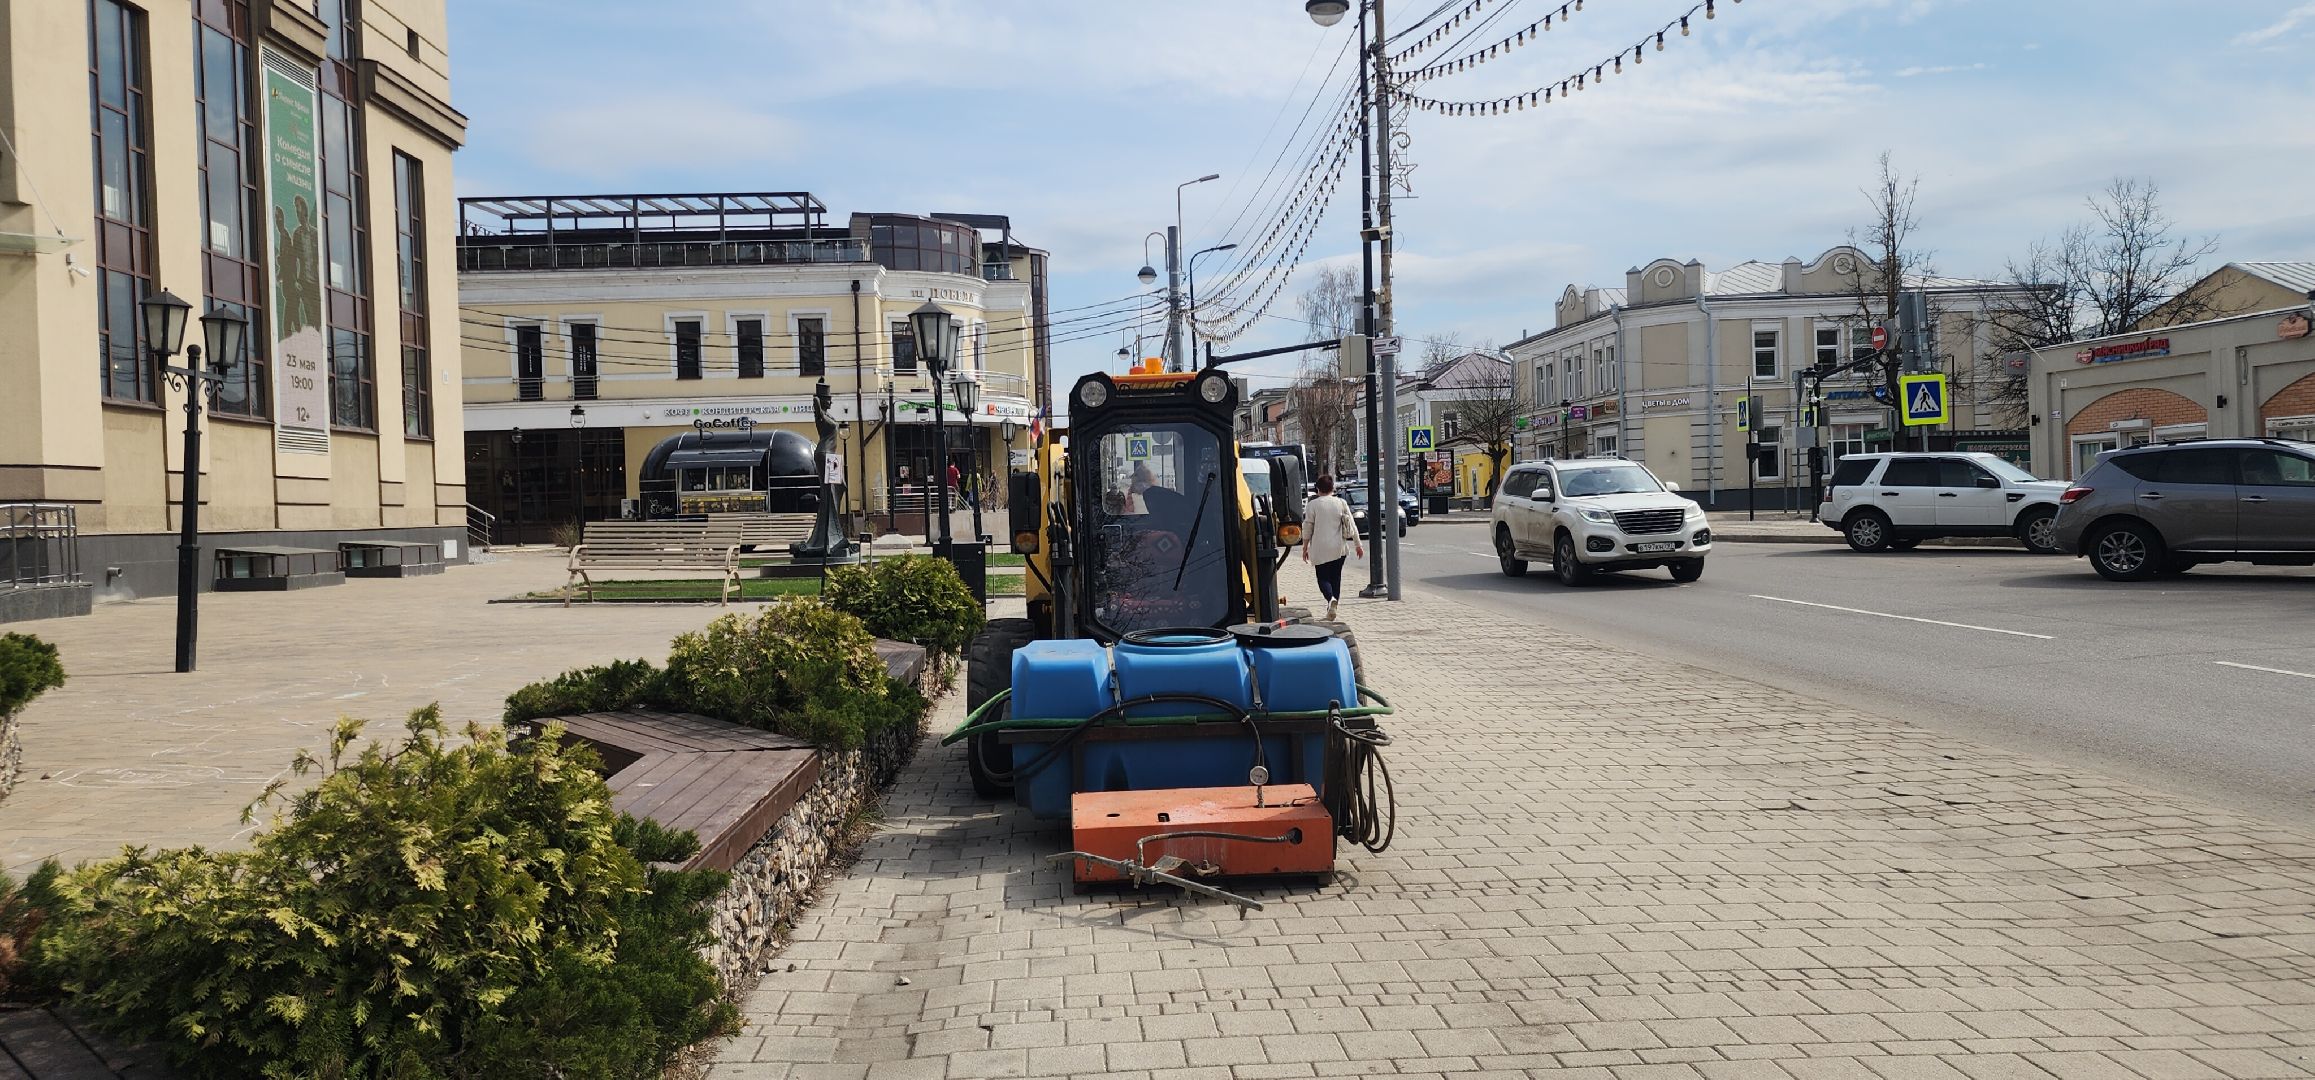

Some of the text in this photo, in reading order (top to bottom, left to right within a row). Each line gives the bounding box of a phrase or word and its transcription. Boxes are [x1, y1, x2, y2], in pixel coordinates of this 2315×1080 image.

[277, 135, 312, 161] Комедия
[274, 153, 312, 176] о смысле
[287, 171, 312, 191] жизни
[286, 353, 316, 371] 23 мая
[291, 375, 314, 391] 19:00
[1672, 398, 1690, 406] ДОМ
[296, 406, 310, 422] 12+
[664, 409, 691, 417] КОФЕ
[702, 405, 782, 415] КОНДИТЕРСКАЯ
